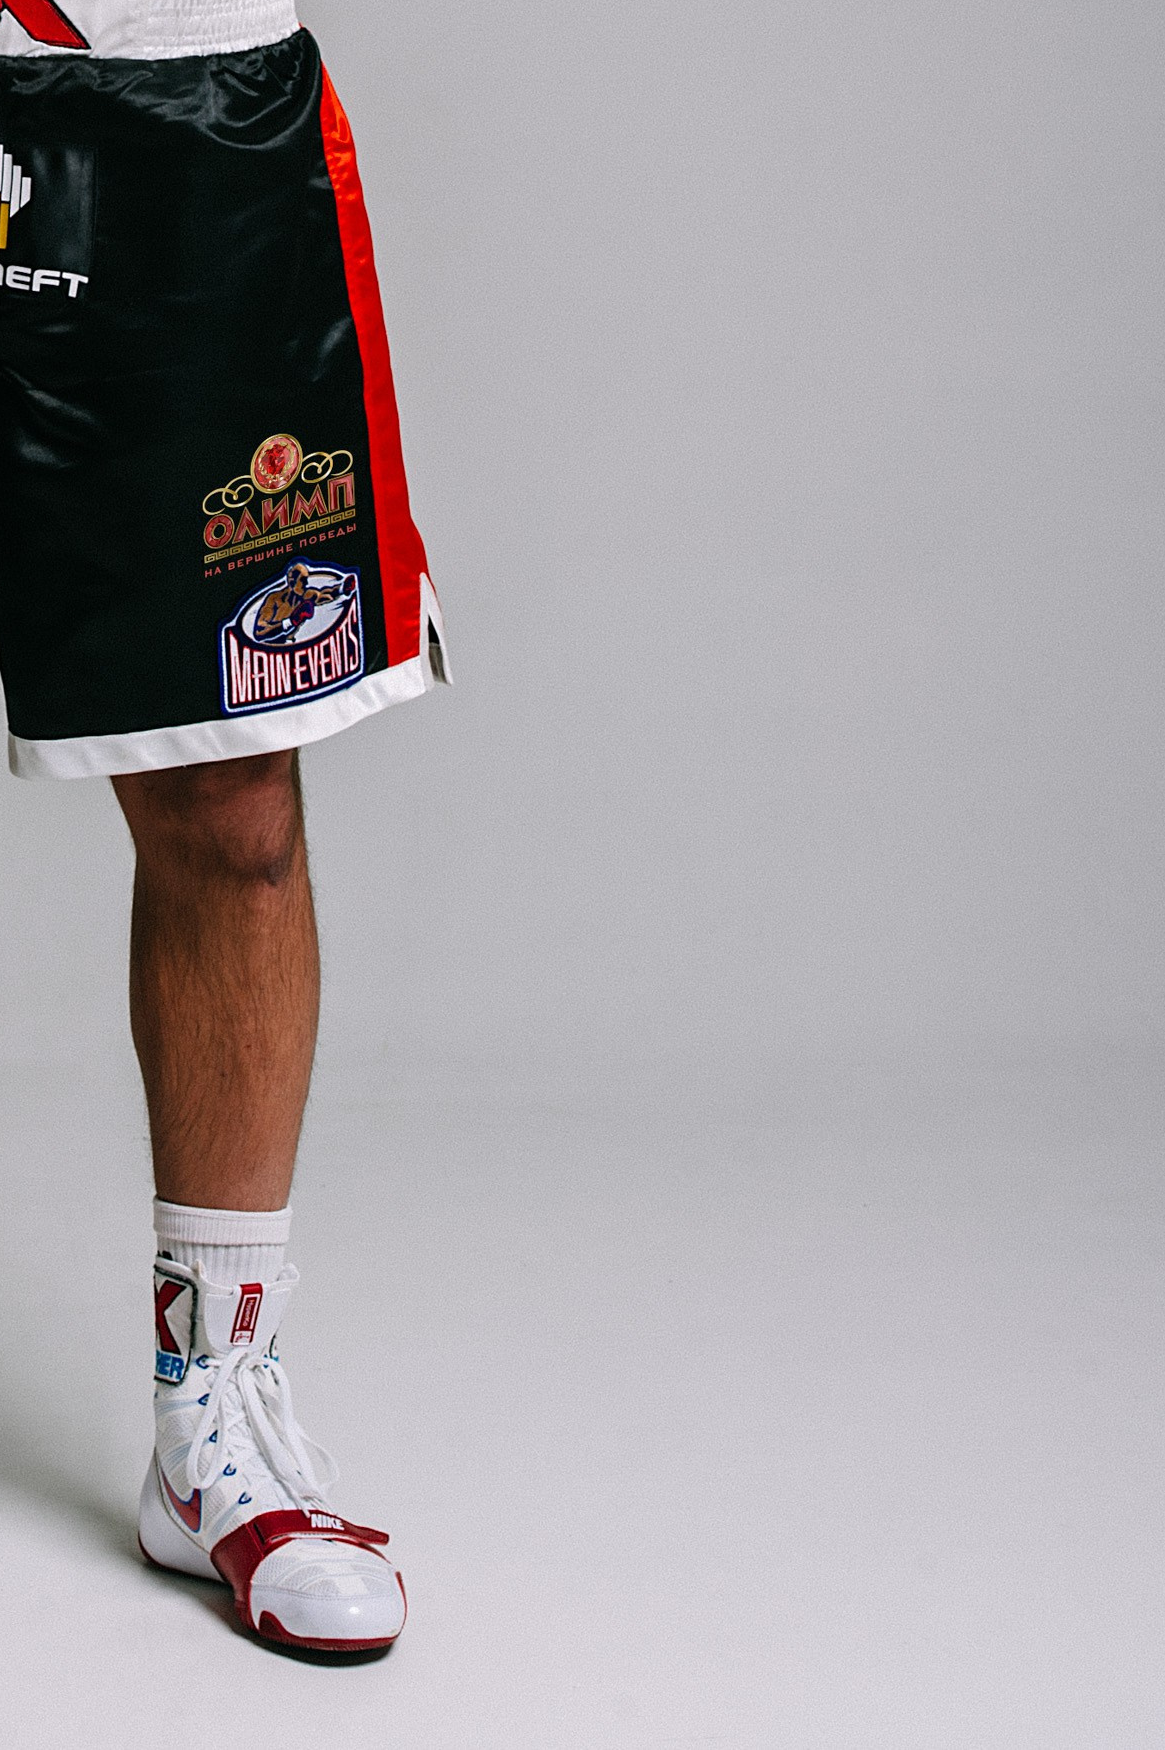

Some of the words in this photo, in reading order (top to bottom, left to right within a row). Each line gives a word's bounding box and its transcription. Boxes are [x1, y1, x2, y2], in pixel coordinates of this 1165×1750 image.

[203, 472, 356, 549] ОЛИМП
[204, 568, 222, 578] НА
[227, 543, 294, 571] ВЕРШИНЕ
[299, 522, 357, 549] ПОБЕДЫ
[229, 630, 292, 705] MAIN
[293, 598, 359, 691] EVENTS
[310, 1513, 345, 1531] NIKE
